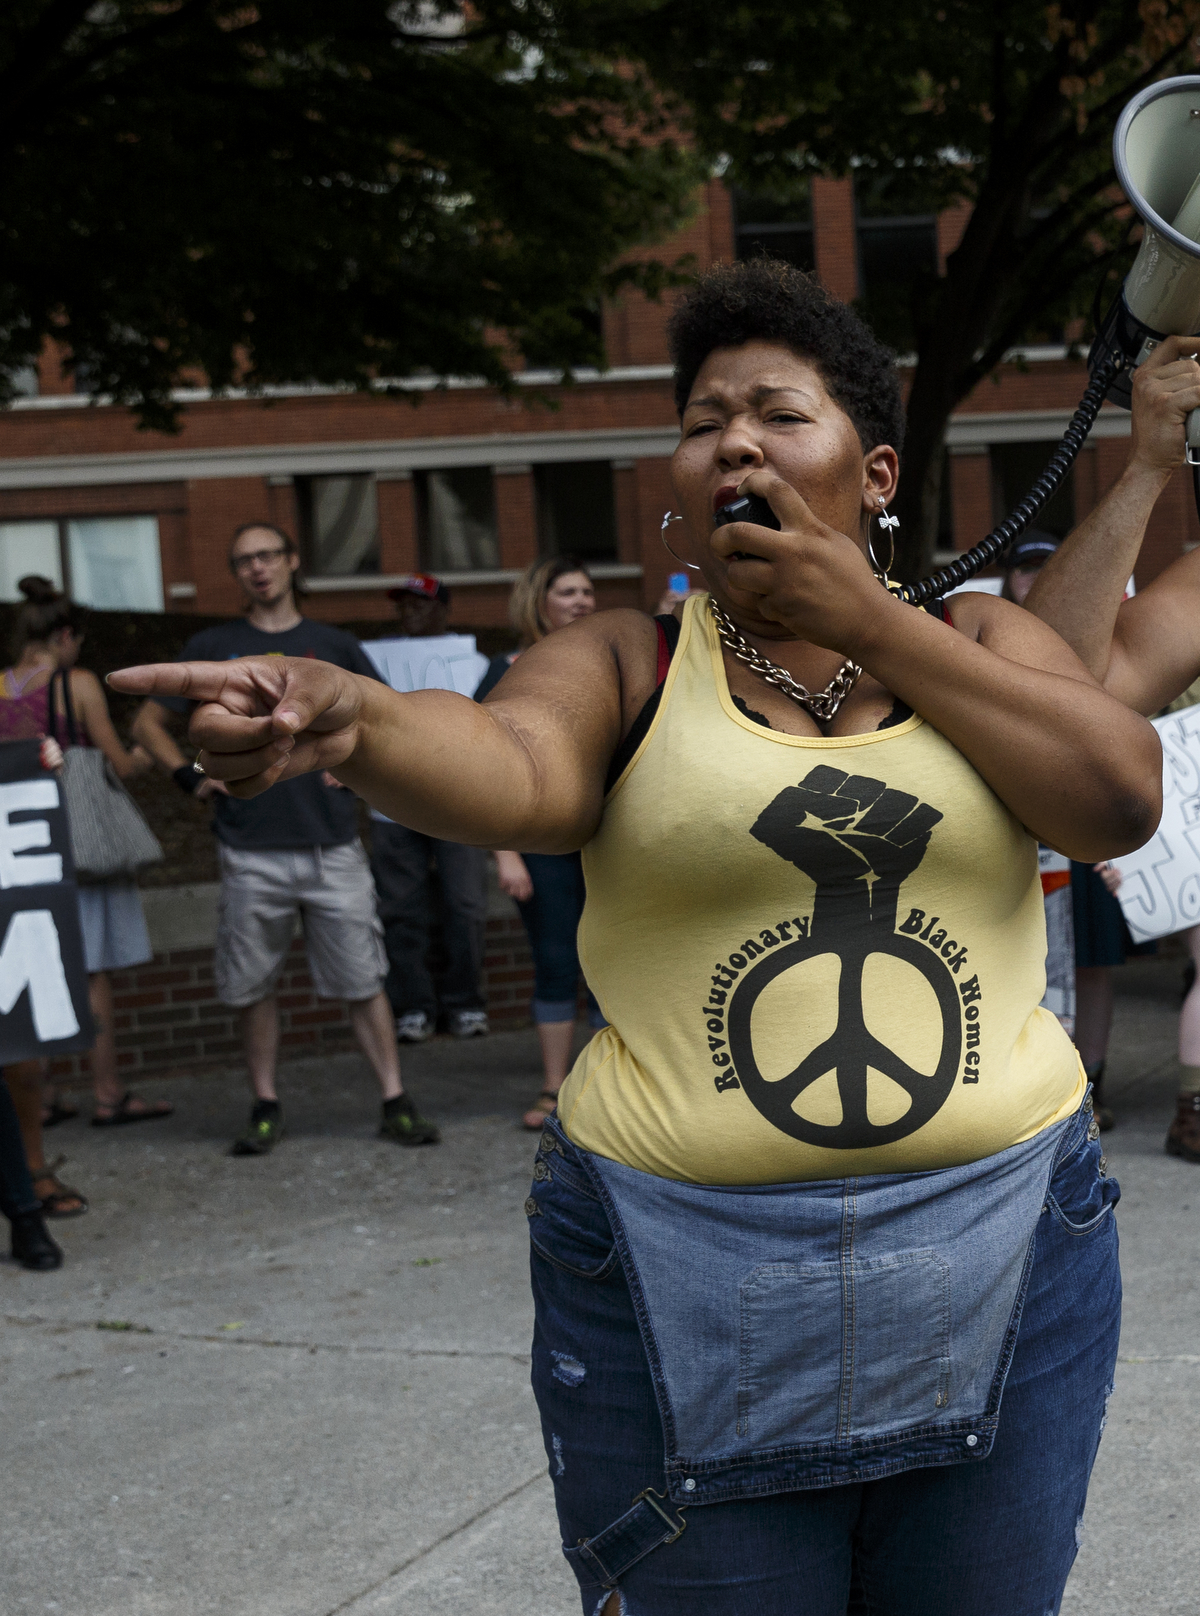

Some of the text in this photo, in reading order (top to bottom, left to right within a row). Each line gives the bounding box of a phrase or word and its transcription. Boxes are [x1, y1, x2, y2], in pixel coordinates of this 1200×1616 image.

[702, 907, 982, 1094] Revolutionary Black Women
